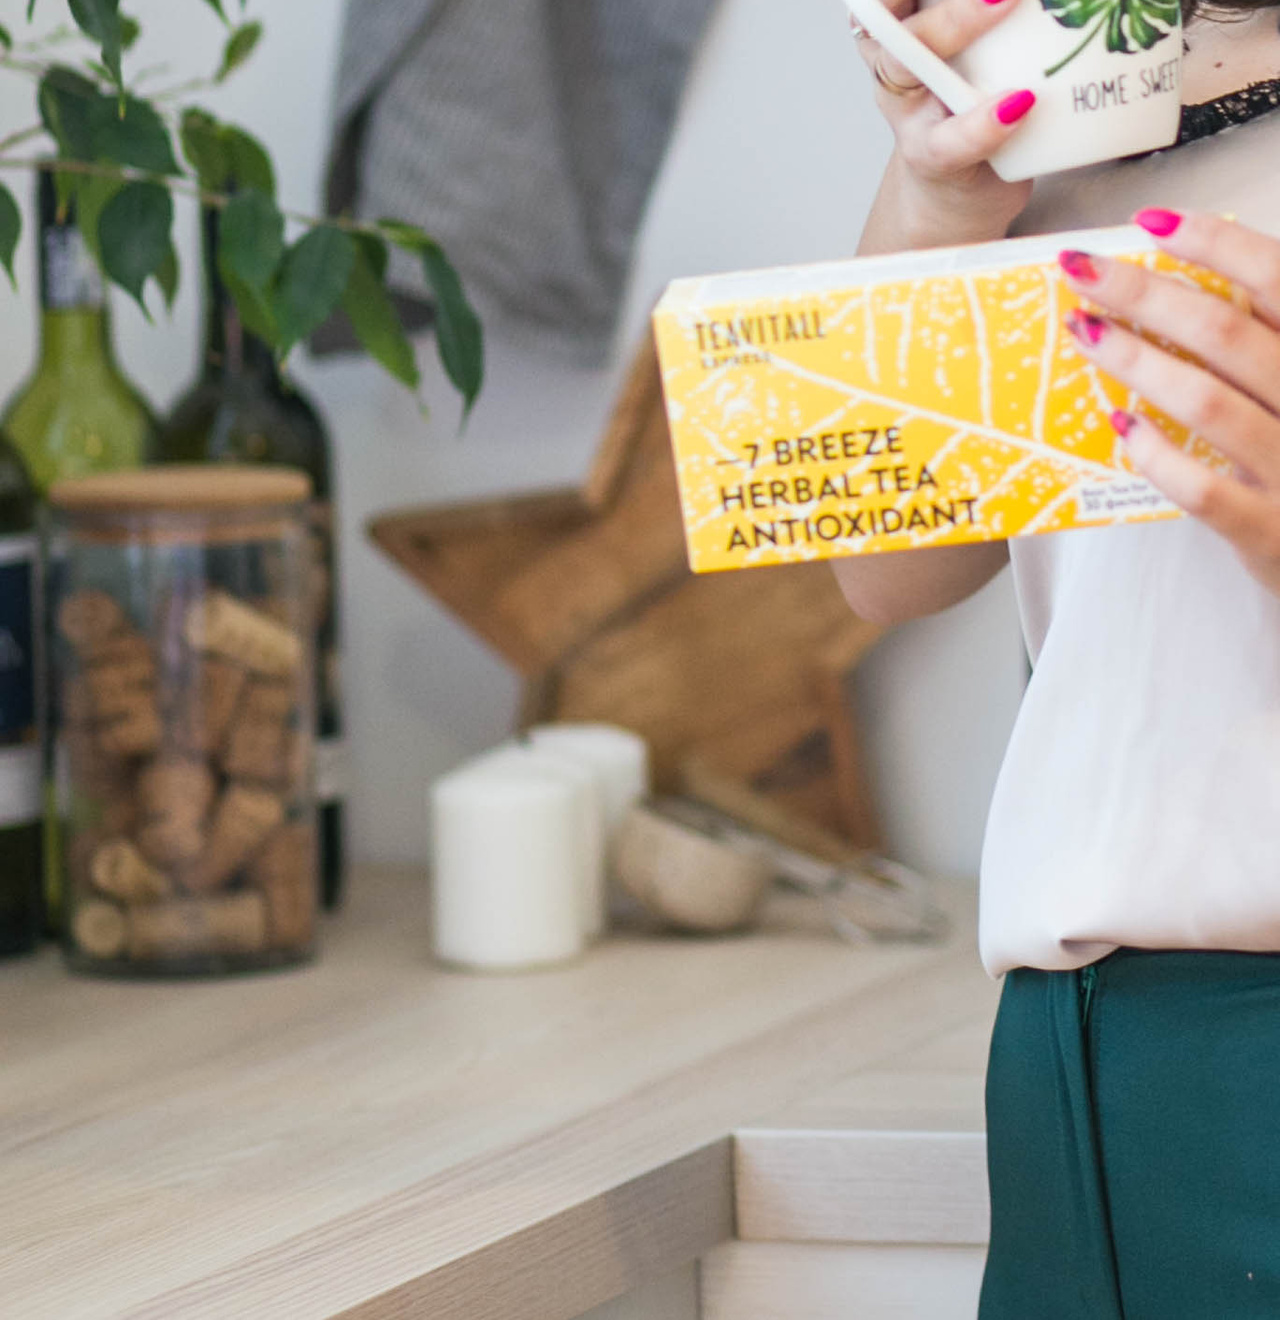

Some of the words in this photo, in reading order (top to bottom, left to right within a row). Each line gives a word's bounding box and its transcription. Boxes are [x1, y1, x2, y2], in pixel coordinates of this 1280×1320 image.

[1072, 74, 1128, 113] HOME
[695, 311, 827, 352] TEAVITALL
[773, 427, 903, 466] BREEZE
[719, 473, 863, 512] HERBAL
[868, 465, 939, 495] TEA
[727, 497, 979, 551] ANTIOXIDANT
